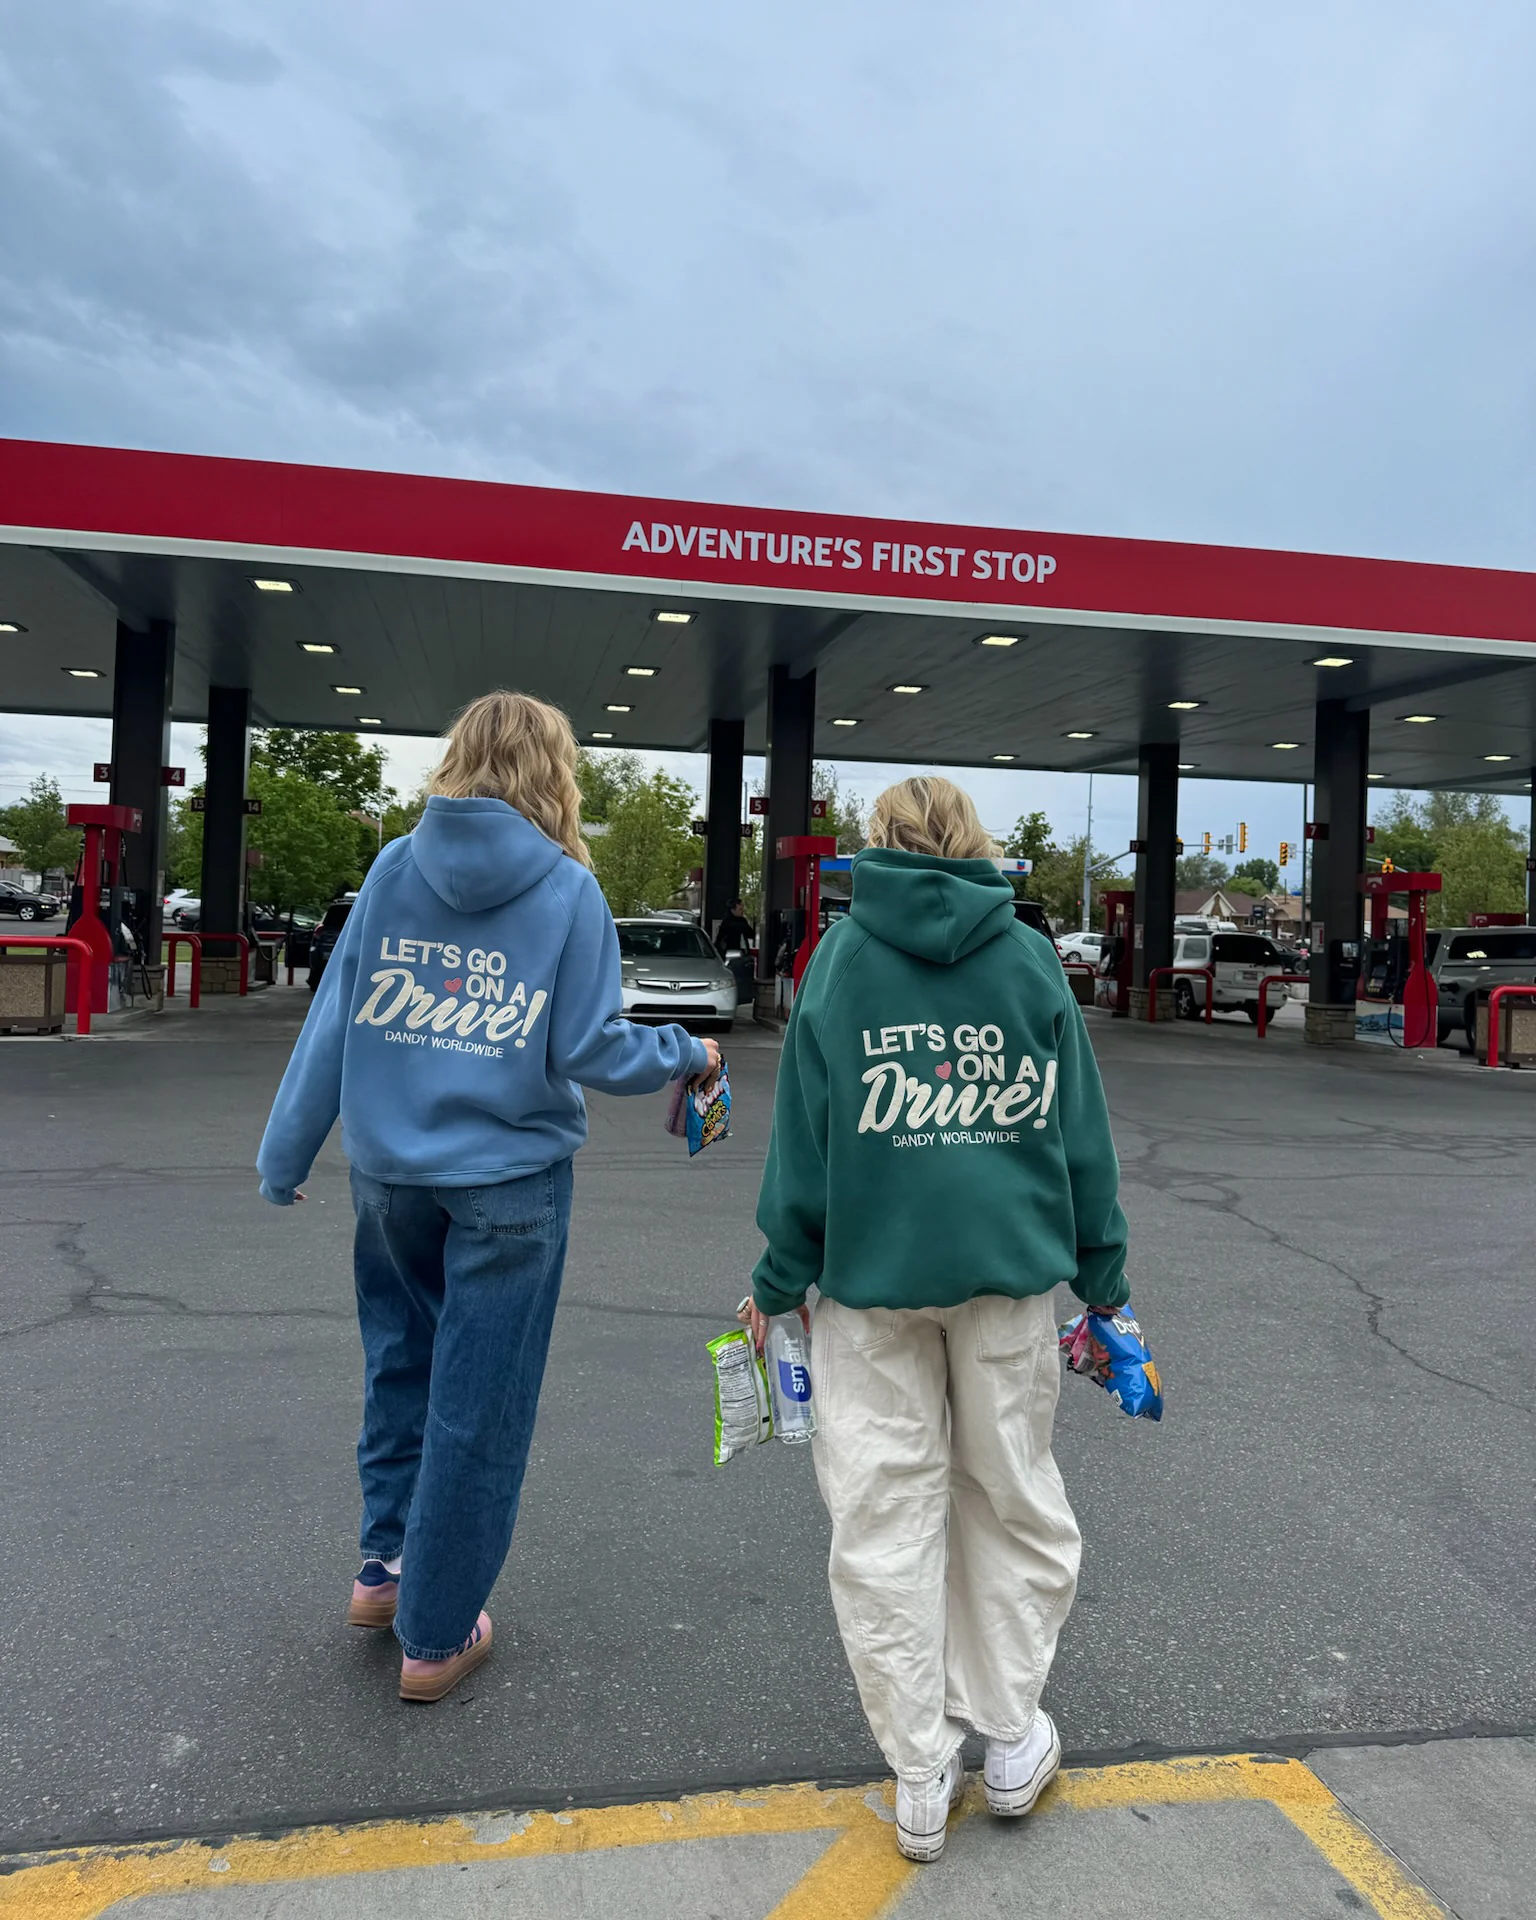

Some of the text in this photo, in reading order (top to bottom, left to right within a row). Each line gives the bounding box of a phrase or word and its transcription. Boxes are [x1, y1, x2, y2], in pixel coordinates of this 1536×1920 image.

[622, 521, 1057, 583] ADVENTURE'S FIRST STOP
[100, 766, 109, 779] 3
[171, 770, 181, 782] 4
[193, 800, 205, 810] 13
[247, 801, 259, 812] 14
[754, 800, 762, 812] 5
[813, 804, 822, 815] 6
[694, 822, 704, 833] 15
[741, 825, 751, 836] 16
[1309, 825, 1317, 837] 7
[380, 936, 507, 976] LET'S GO
[465, 973, 527, 1007] ON A
[354, 968, 548, 1049] Drive!
[384, 1030, 504, 1059] DANDY WORLDWIDE
[862, 1023, 1004, 1057] LET'S GO
[956, 1053, 1041, 1083] ON A
[857, 1059, 1058, 1134] Drive!
[892, 1130, 1020, 1147] DANDY WORLDWIDE
[784, 1337, 806, 1394] smart
